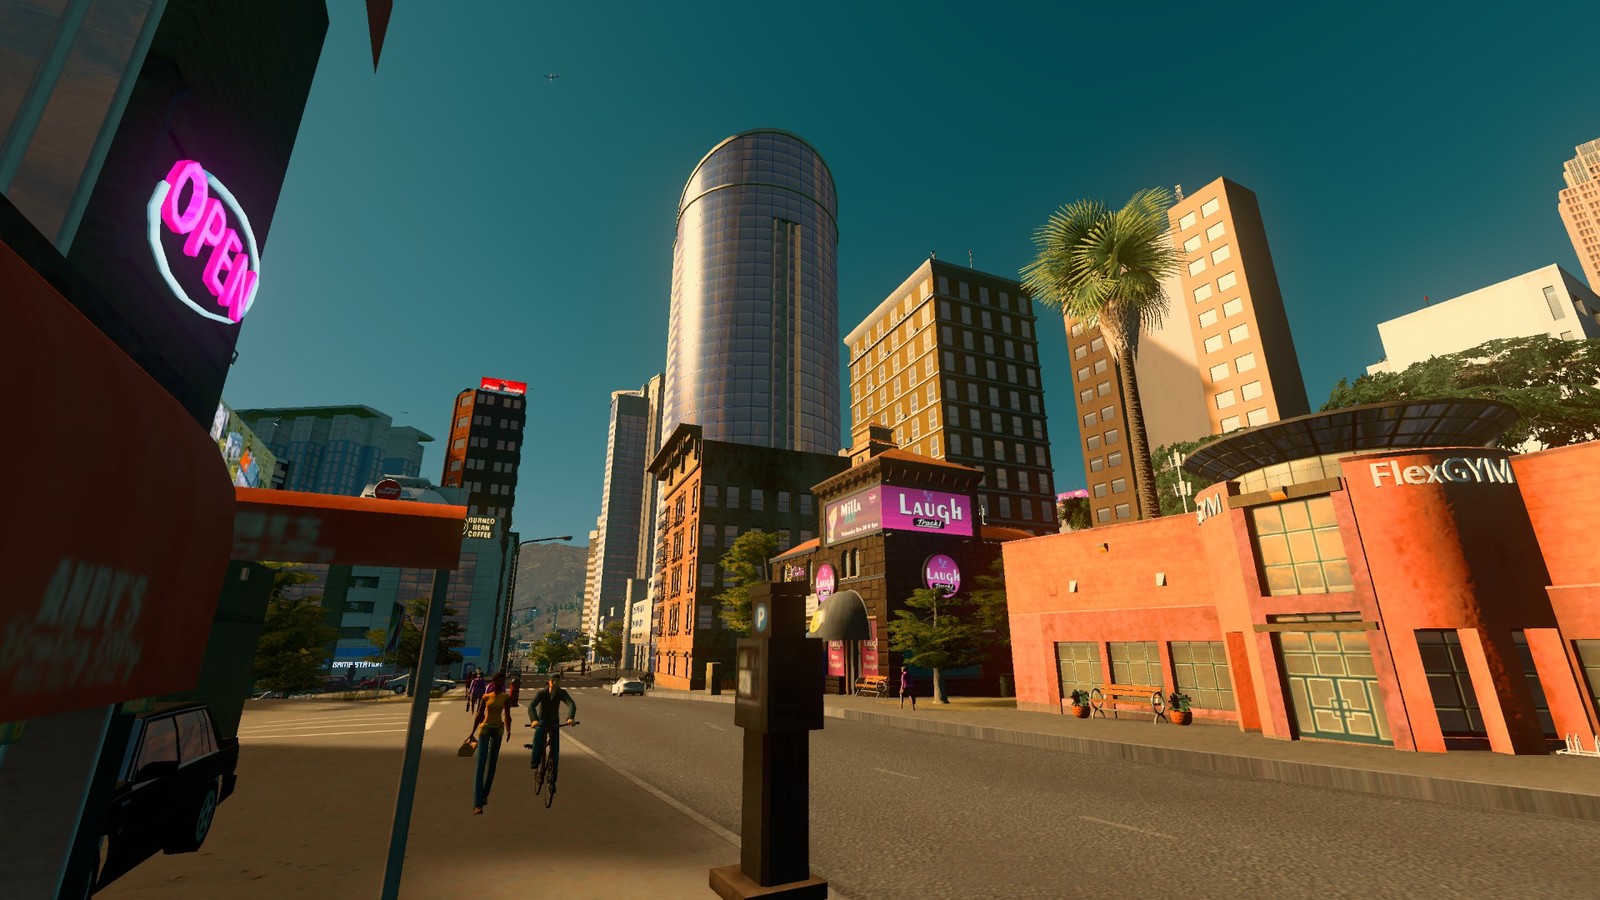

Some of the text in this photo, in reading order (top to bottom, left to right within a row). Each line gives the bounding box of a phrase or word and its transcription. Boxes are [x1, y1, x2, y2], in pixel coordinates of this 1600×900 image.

[162, 160, 257, 323] OPEN
[1369, 458, 1515, 488] FlexGYM
[468, 517, 495, 525] BURNED
[917, 519, 942, 527] Track!
[467, 530, 491, 538] COFFEE
[757, 606, 765, 628] P
